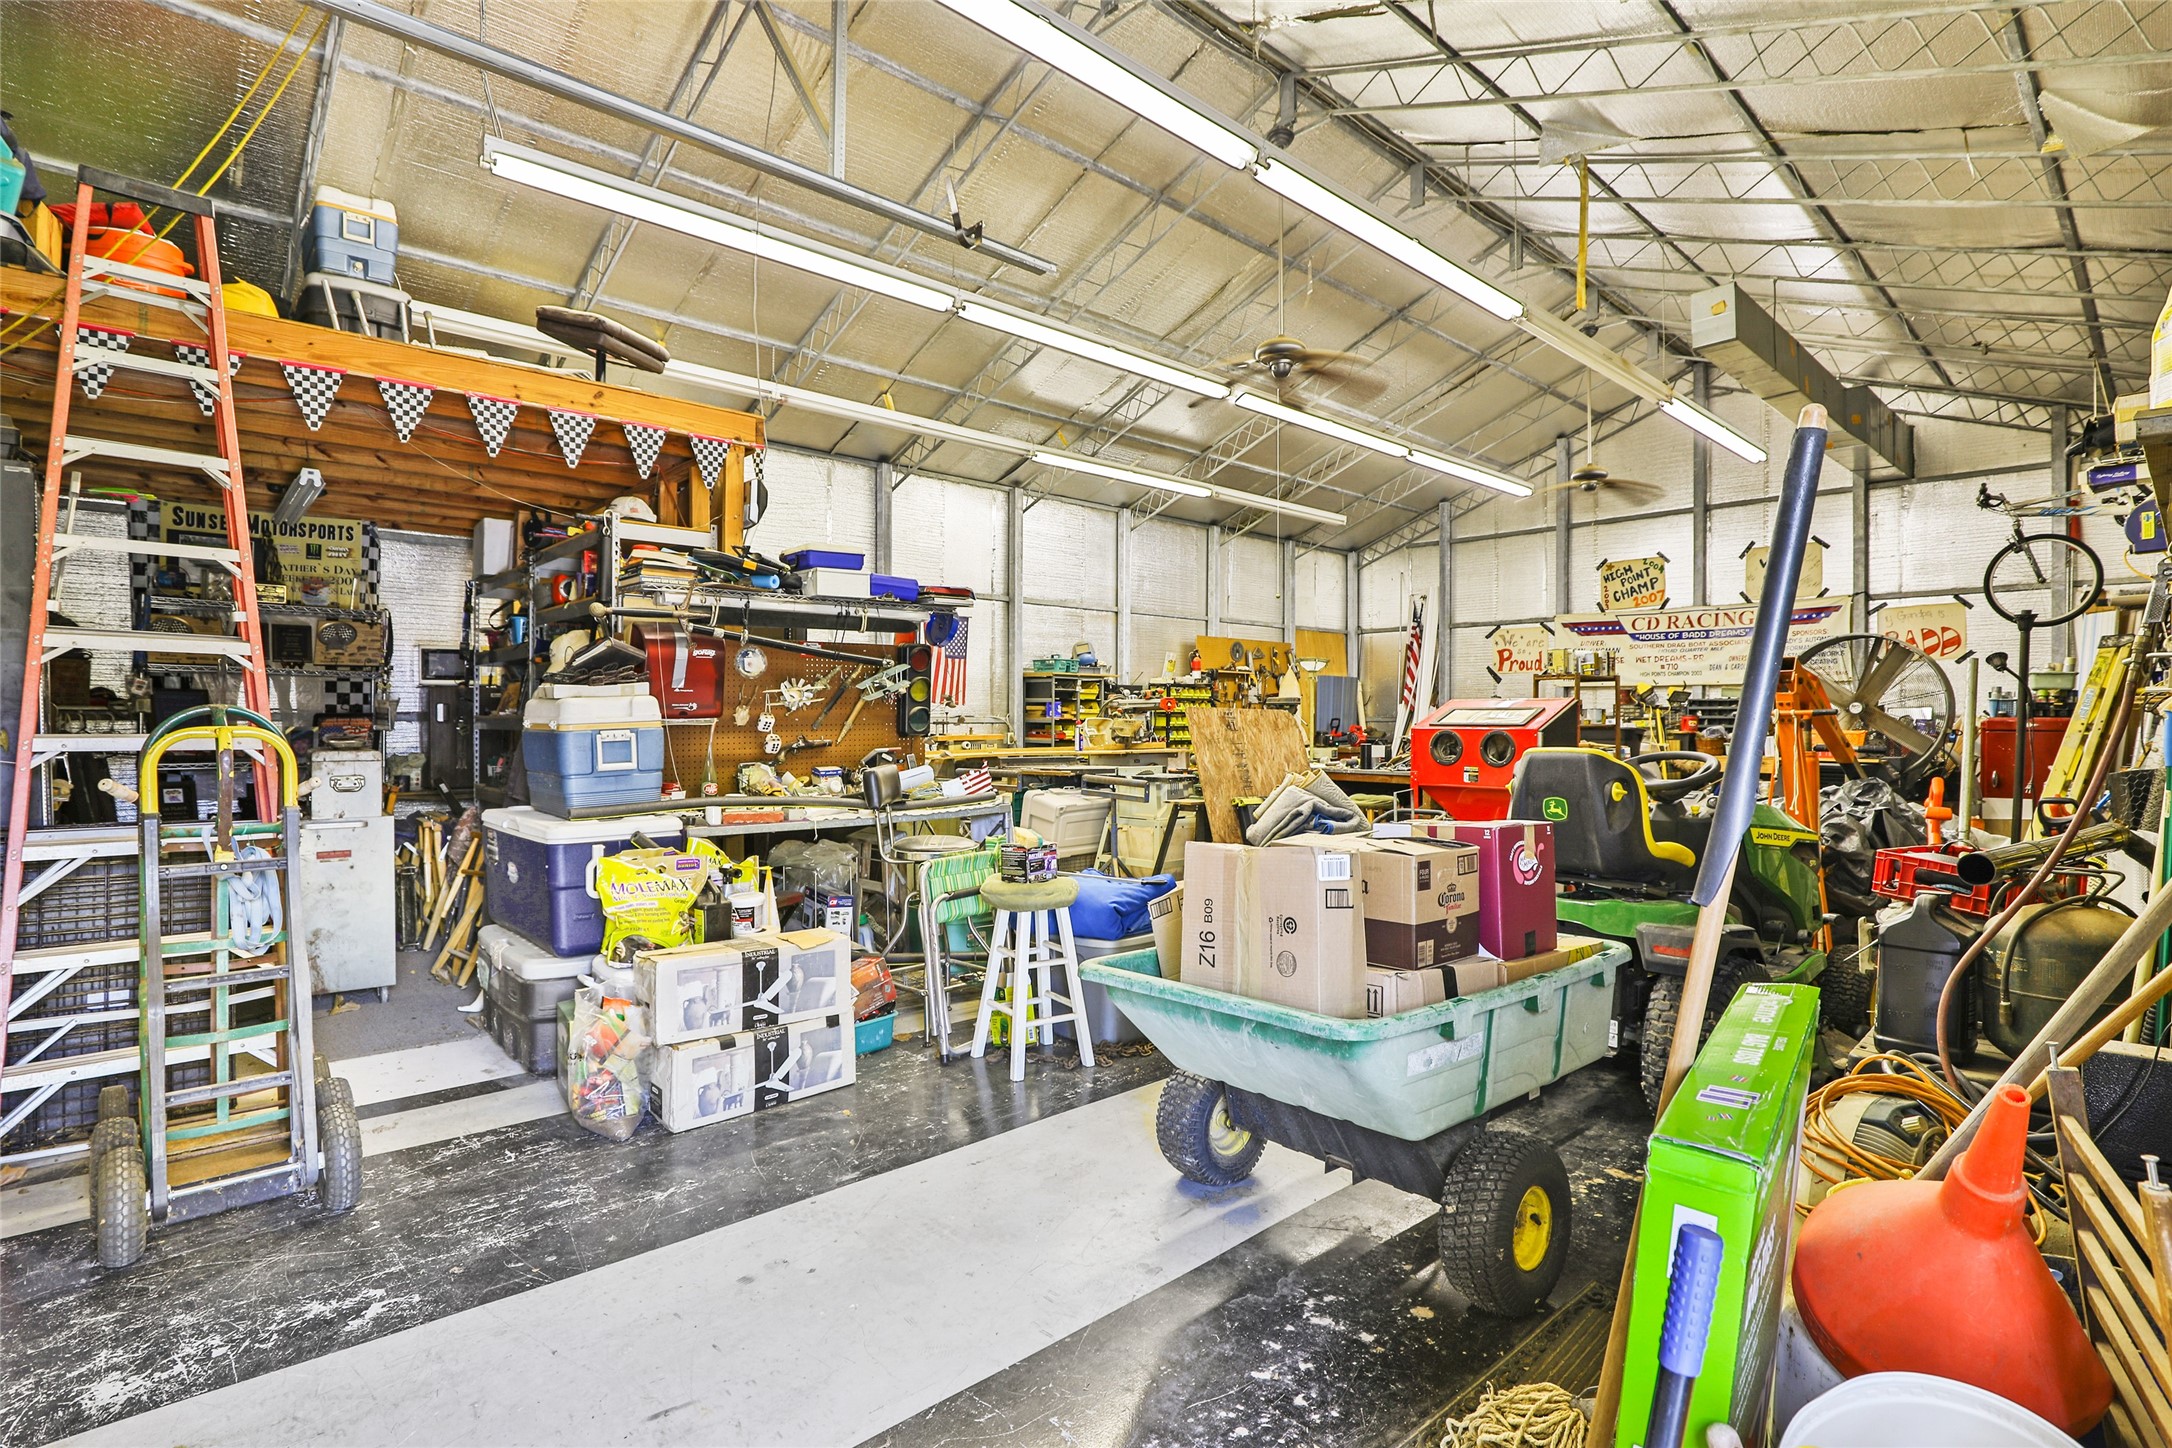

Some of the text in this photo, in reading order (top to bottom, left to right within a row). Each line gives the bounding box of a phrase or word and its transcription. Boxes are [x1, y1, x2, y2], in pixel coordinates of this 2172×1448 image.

[172, 506, 227, 530] SUNSE
[1603, 565, 1633, 583] HIGH
[1620, 567, 1651, 587] POINT
[1613, 577, 1659, 602] CHAMP
[1633, 590, 1665, 607] 2007
[1631, 610, 1755, 631] CD RACING
[1682, 631, 1707, 639] BADD
[1629, 642, 1665, 650] SOUTHERN
[1709, 639, 1751, 647] ASSOCIATIO
[1496, 648, 1543, 672] Proud
[1756, 831, 1790, 841] JOHN DEERE
[611, 878, 689, 895] MOLEMAX
[1438, 891, 1465, 908] Corona
[1204, 898, 1213, 923] B09
[745, 949, 776, 958] INDUSTRIAL
[1199, 931, 1215, 968] Z16
[757, 1028, 785, 1039] INDUSTRIAL
